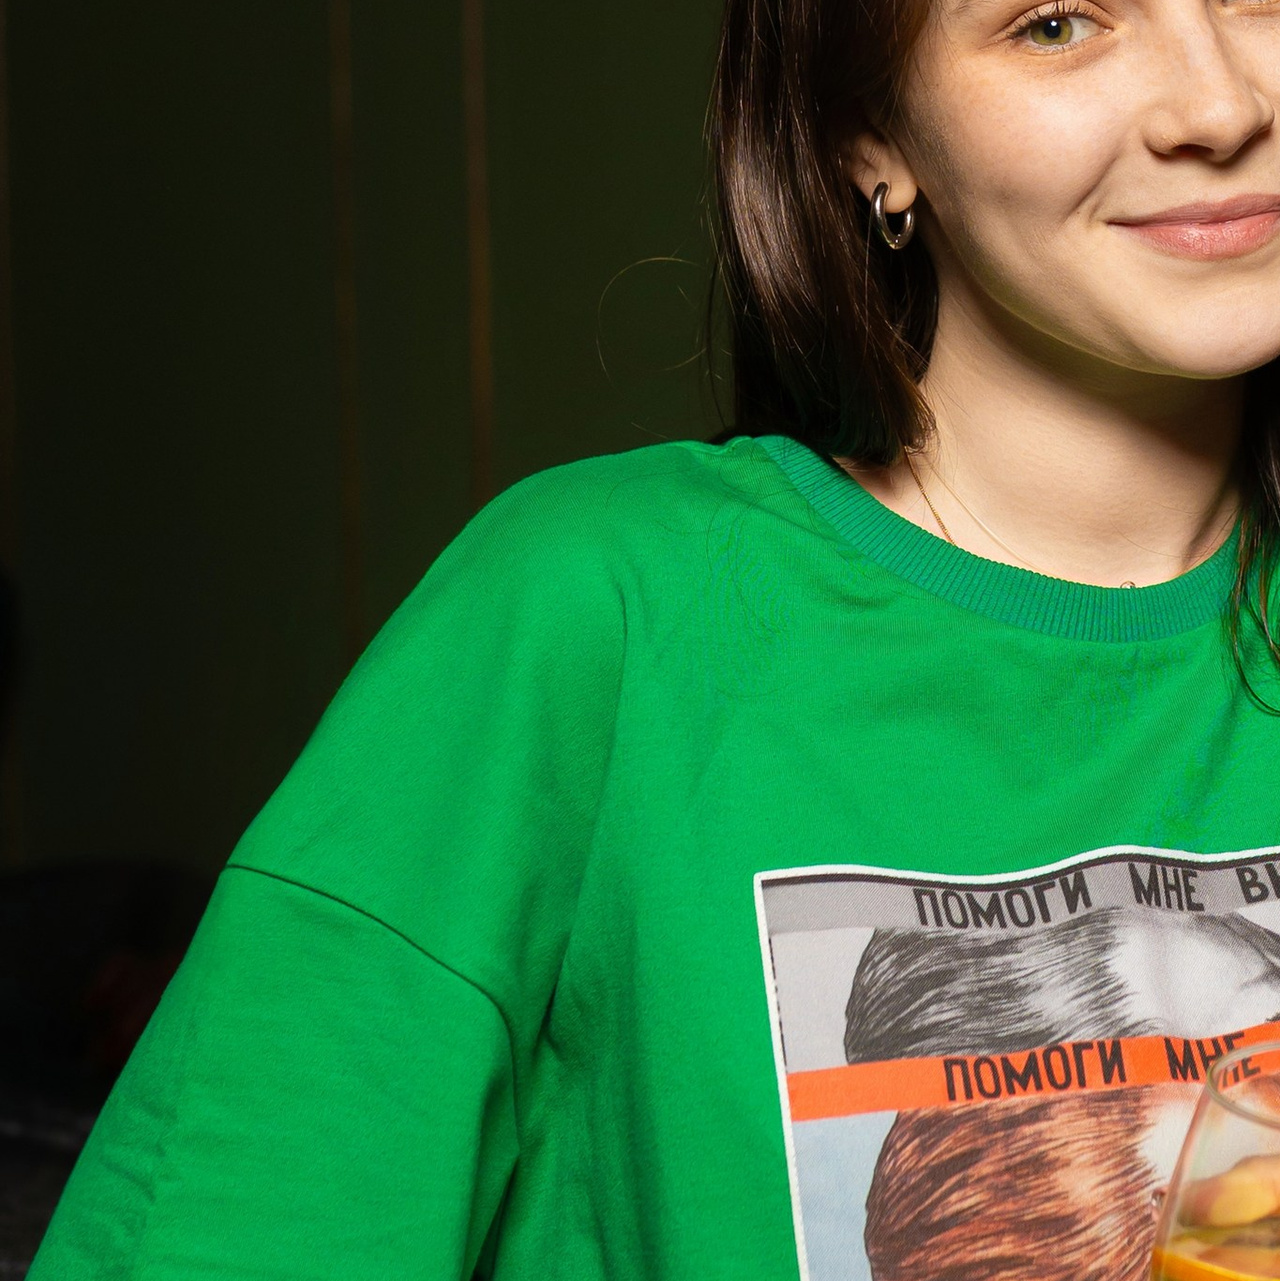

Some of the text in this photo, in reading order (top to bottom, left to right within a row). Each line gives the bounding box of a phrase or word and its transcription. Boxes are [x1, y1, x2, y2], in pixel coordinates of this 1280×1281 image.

[912, 870, 1092, 929] ПОМОГИ
[1128, 862, 1205, 912] МНЕ
[943, 1038, 1127, 1101] ПОМОГИ
[1163, 1031, 1262, 1088] МНЕ
